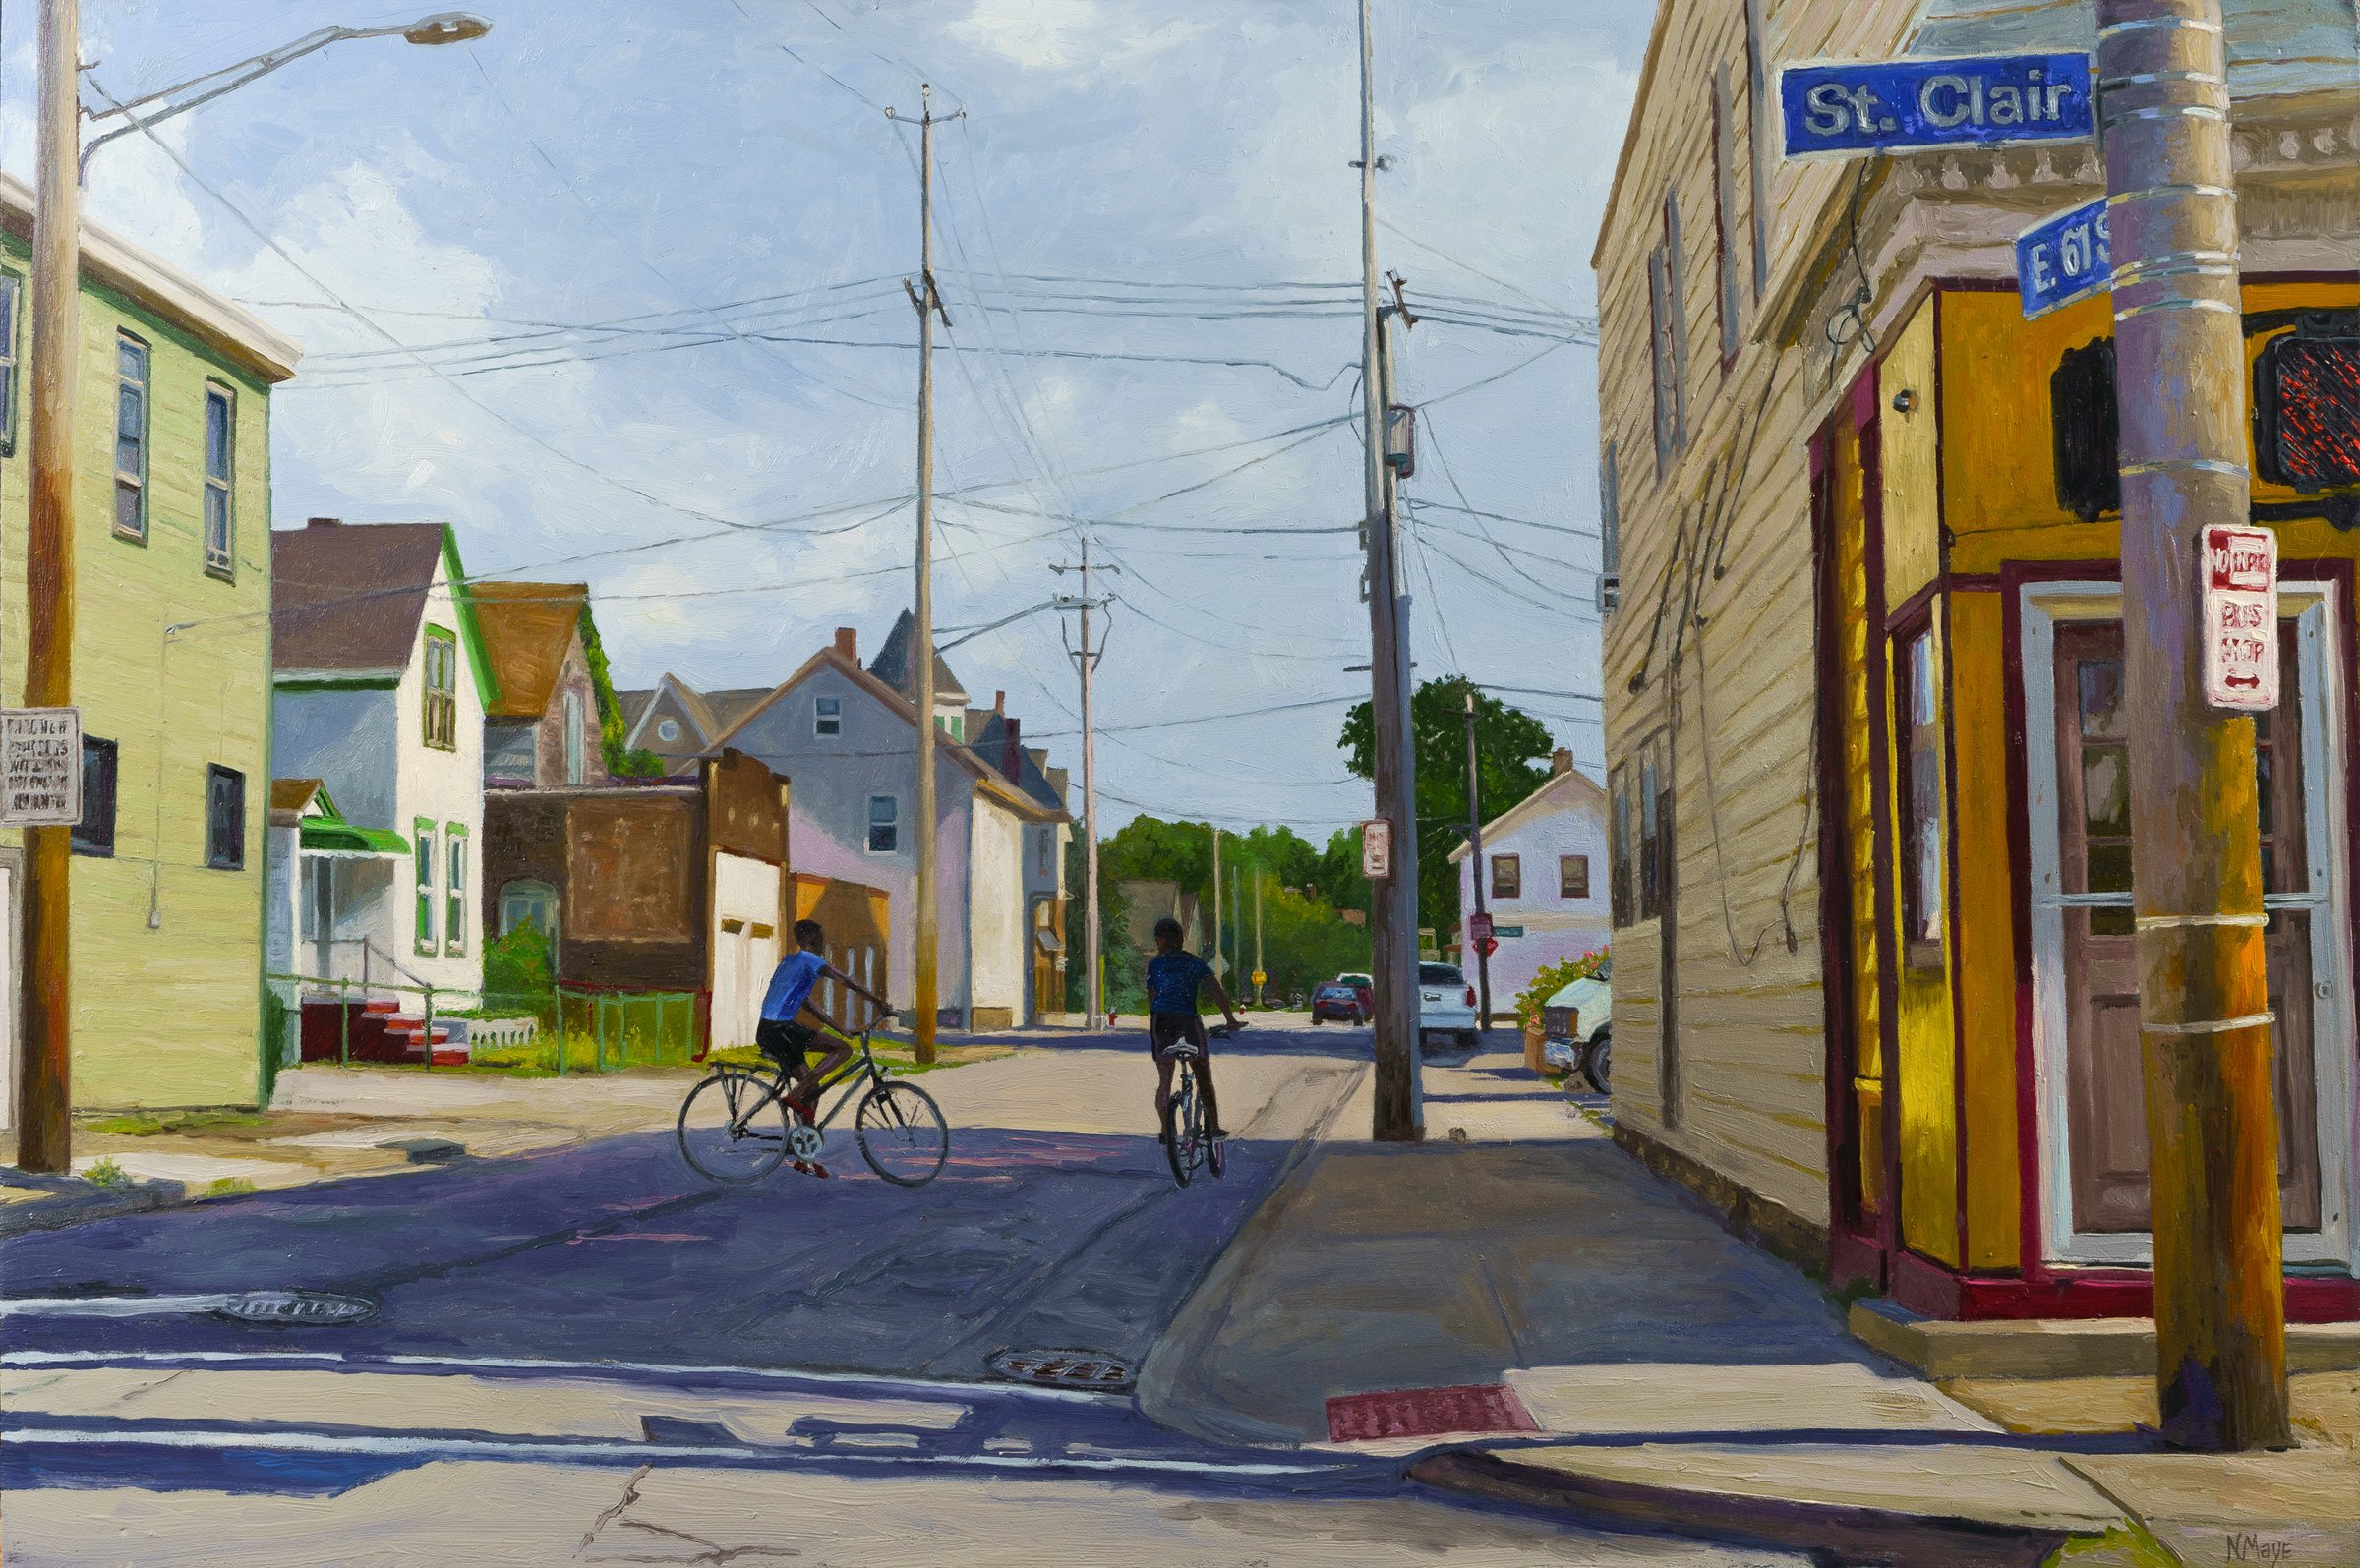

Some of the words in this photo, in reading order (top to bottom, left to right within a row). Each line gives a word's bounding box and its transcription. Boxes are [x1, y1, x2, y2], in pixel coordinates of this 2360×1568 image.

[1804, 83, 1898, 137] St.
[1919, 68, 2073, 128] Clair
[2032, 243, 2057, 294] E.
[2220, 602, 2263, 628] BUS
